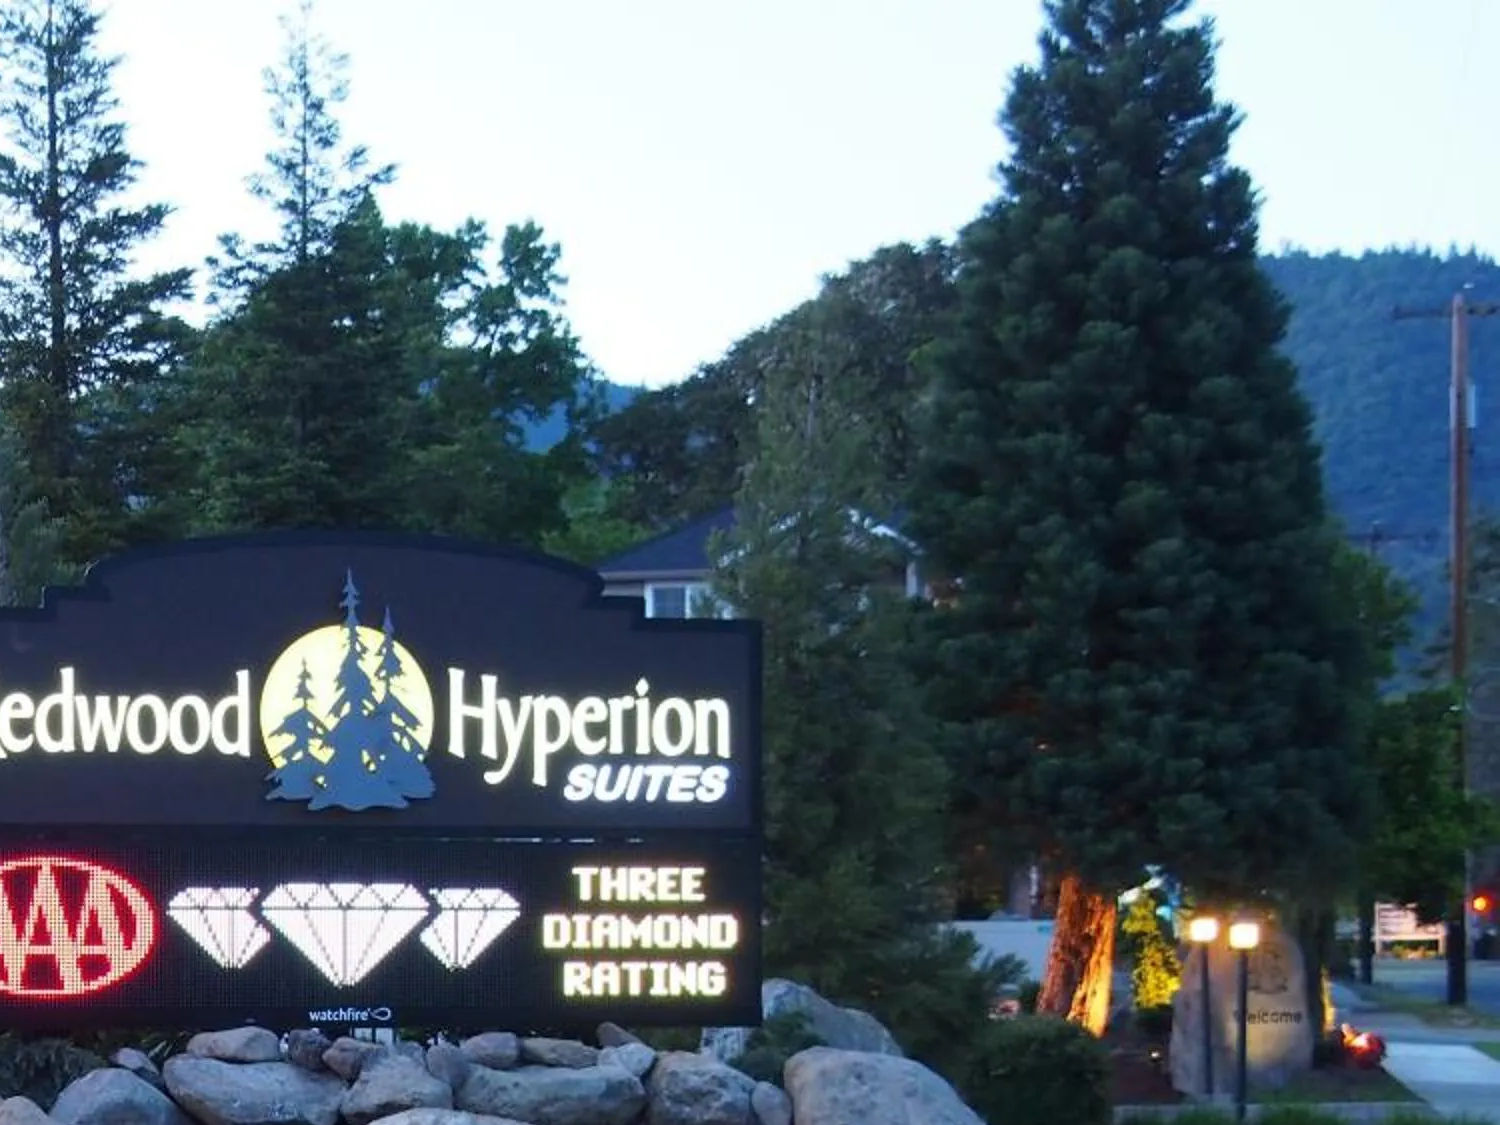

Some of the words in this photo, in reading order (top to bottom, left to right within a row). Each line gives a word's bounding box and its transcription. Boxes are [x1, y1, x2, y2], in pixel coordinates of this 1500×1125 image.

[447, 667, 732, 787] Hyperion
[562, 763, 731, 802] SUITES
[571, 866, 706, 901] THREE
[543, 913, 739, 949] DIAMOND
[563, 960, 727, 997] RATING
[309, 1007, 368, 1021] watchfire
